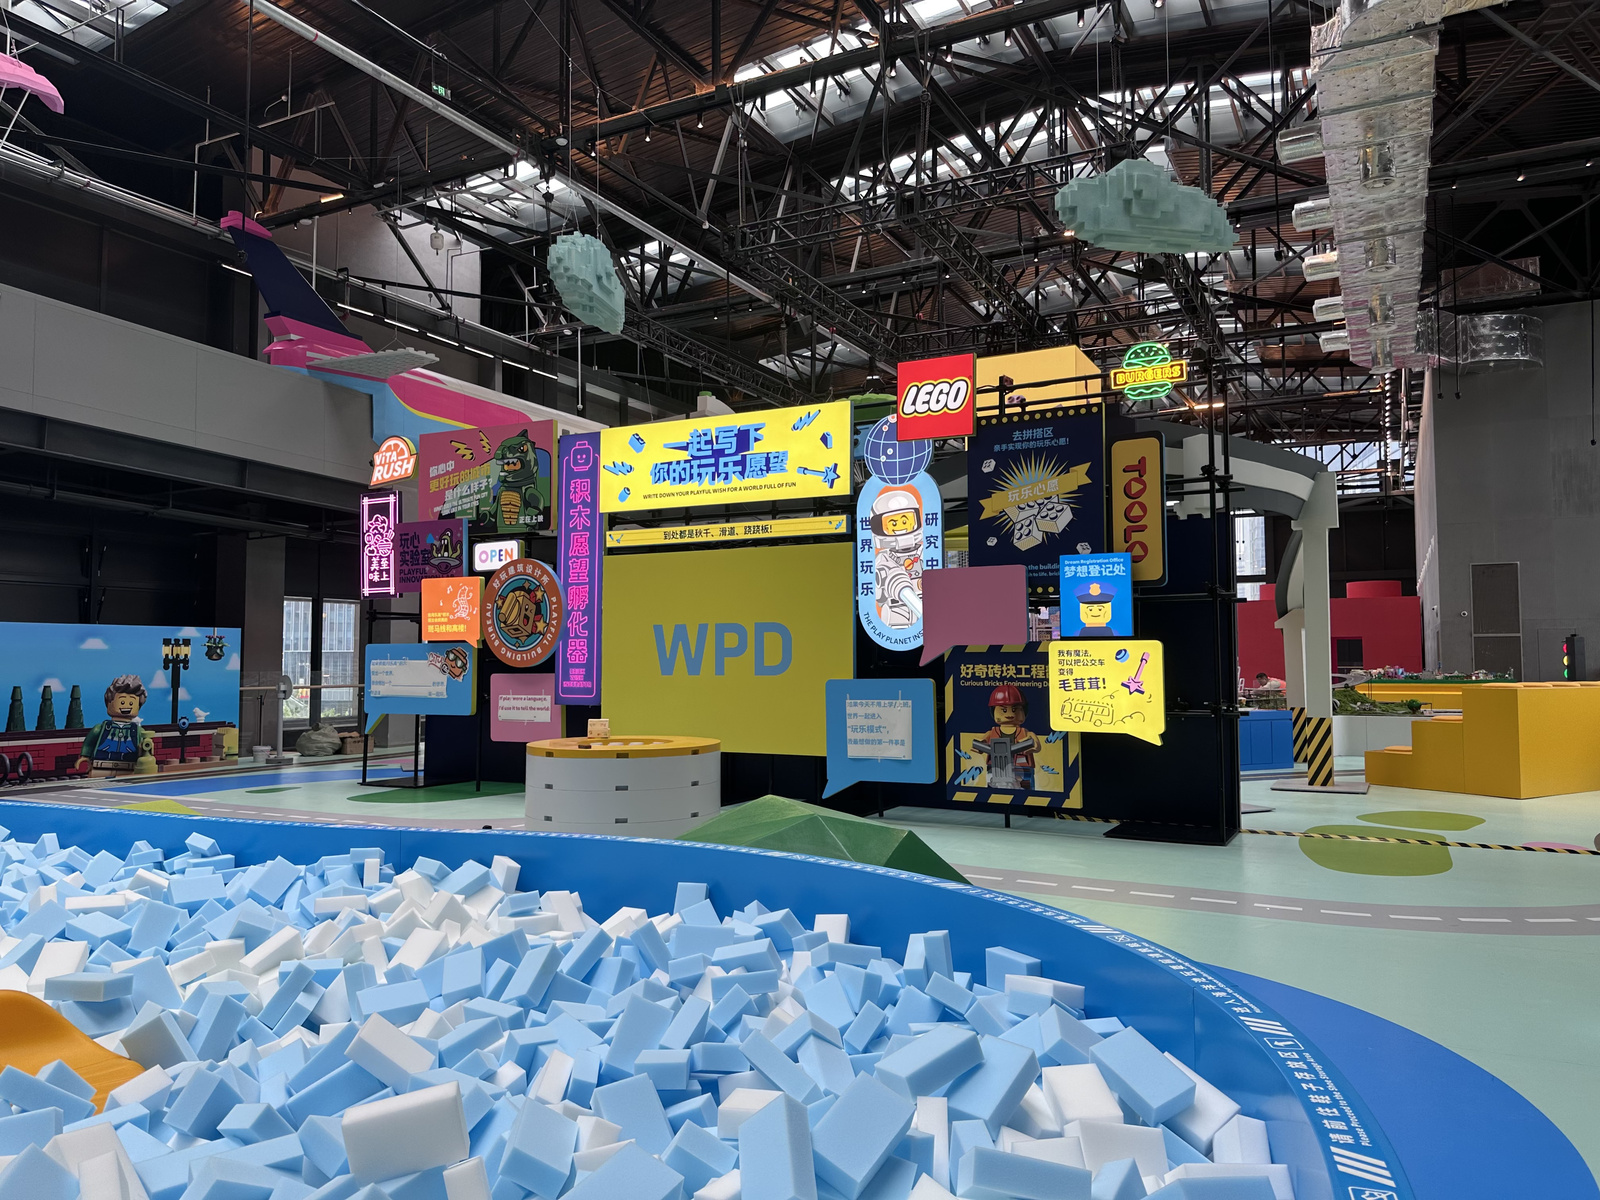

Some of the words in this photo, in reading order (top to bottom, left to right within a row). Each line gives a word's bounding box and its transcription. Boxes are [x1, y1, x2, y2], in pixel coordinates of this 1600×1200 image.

[1116, 366, 1181, 384] BURGERS
[903, 381, 967, 414] LEGO
[663, 423, 766, 459] 一起写下
[1012, 427, 1053, 441] 去拼搭区
[993, 438, 1069, 452] 亲手实现你的玩乐心愿！
[373, 457, 414, 481] RUSH
[430, 461, 454, 477] 你心中
[430, 462, 490, 493] 更好玩的城市
[650, 450, 788, 486] 你的玩乐愿望
[445, 478, 492, 501] 是什么样子？
[1008, 479, 1059, 502] 玩乐心愿
[519, 515, 544, 523] 正在上映
[399, 531, 420, 550] 玩心
[663, 524, 773, 540] 到处都是秋千、滑道、跷跷板！
[925, 512, 939, 569] 研究中
[399, 548, 431, 567] 实验室
[478, 547, 514, 564] OPEN
[860, 516, 874, 596] 世界玩乐
[399, 568, 428, 576] PLAYFUL
[492, 563, 550, 589] 好玩建筑设计所
[567, 478, 591, 664] 积木愿望孵化器
[1064, 563, 1126, 578] 梦想登记处
[485, 603, 501, 647] BUREAU
[543, 596, 558, 645] PLAYFUL
[864, 611, 873, 627] THE
[870, 625, 886, 640] PLAY
[885, 636, 912, 645] PLANET
[500, 646, 542, 661] BUILDING
[653, 622, 793, 676] WPD
[960, 664, 1049, 679] 好奇砖块工程
[1058, 659, 1105, 667] 可以把公交车
[1058, 668, 1074, 676] 变得
[1058, 677, 1107, 692] 毛茸茸！
[1311, 1063, 1329, 1079] Storage
[1324, 1079, 1338, 1091] Shoe
[1278, 1050, 1356, 1144] 请前往鞋子存放区
[1341, 1106, 1361, 1127] Proceed
[1356, 1128, 1372, 1146] Please
